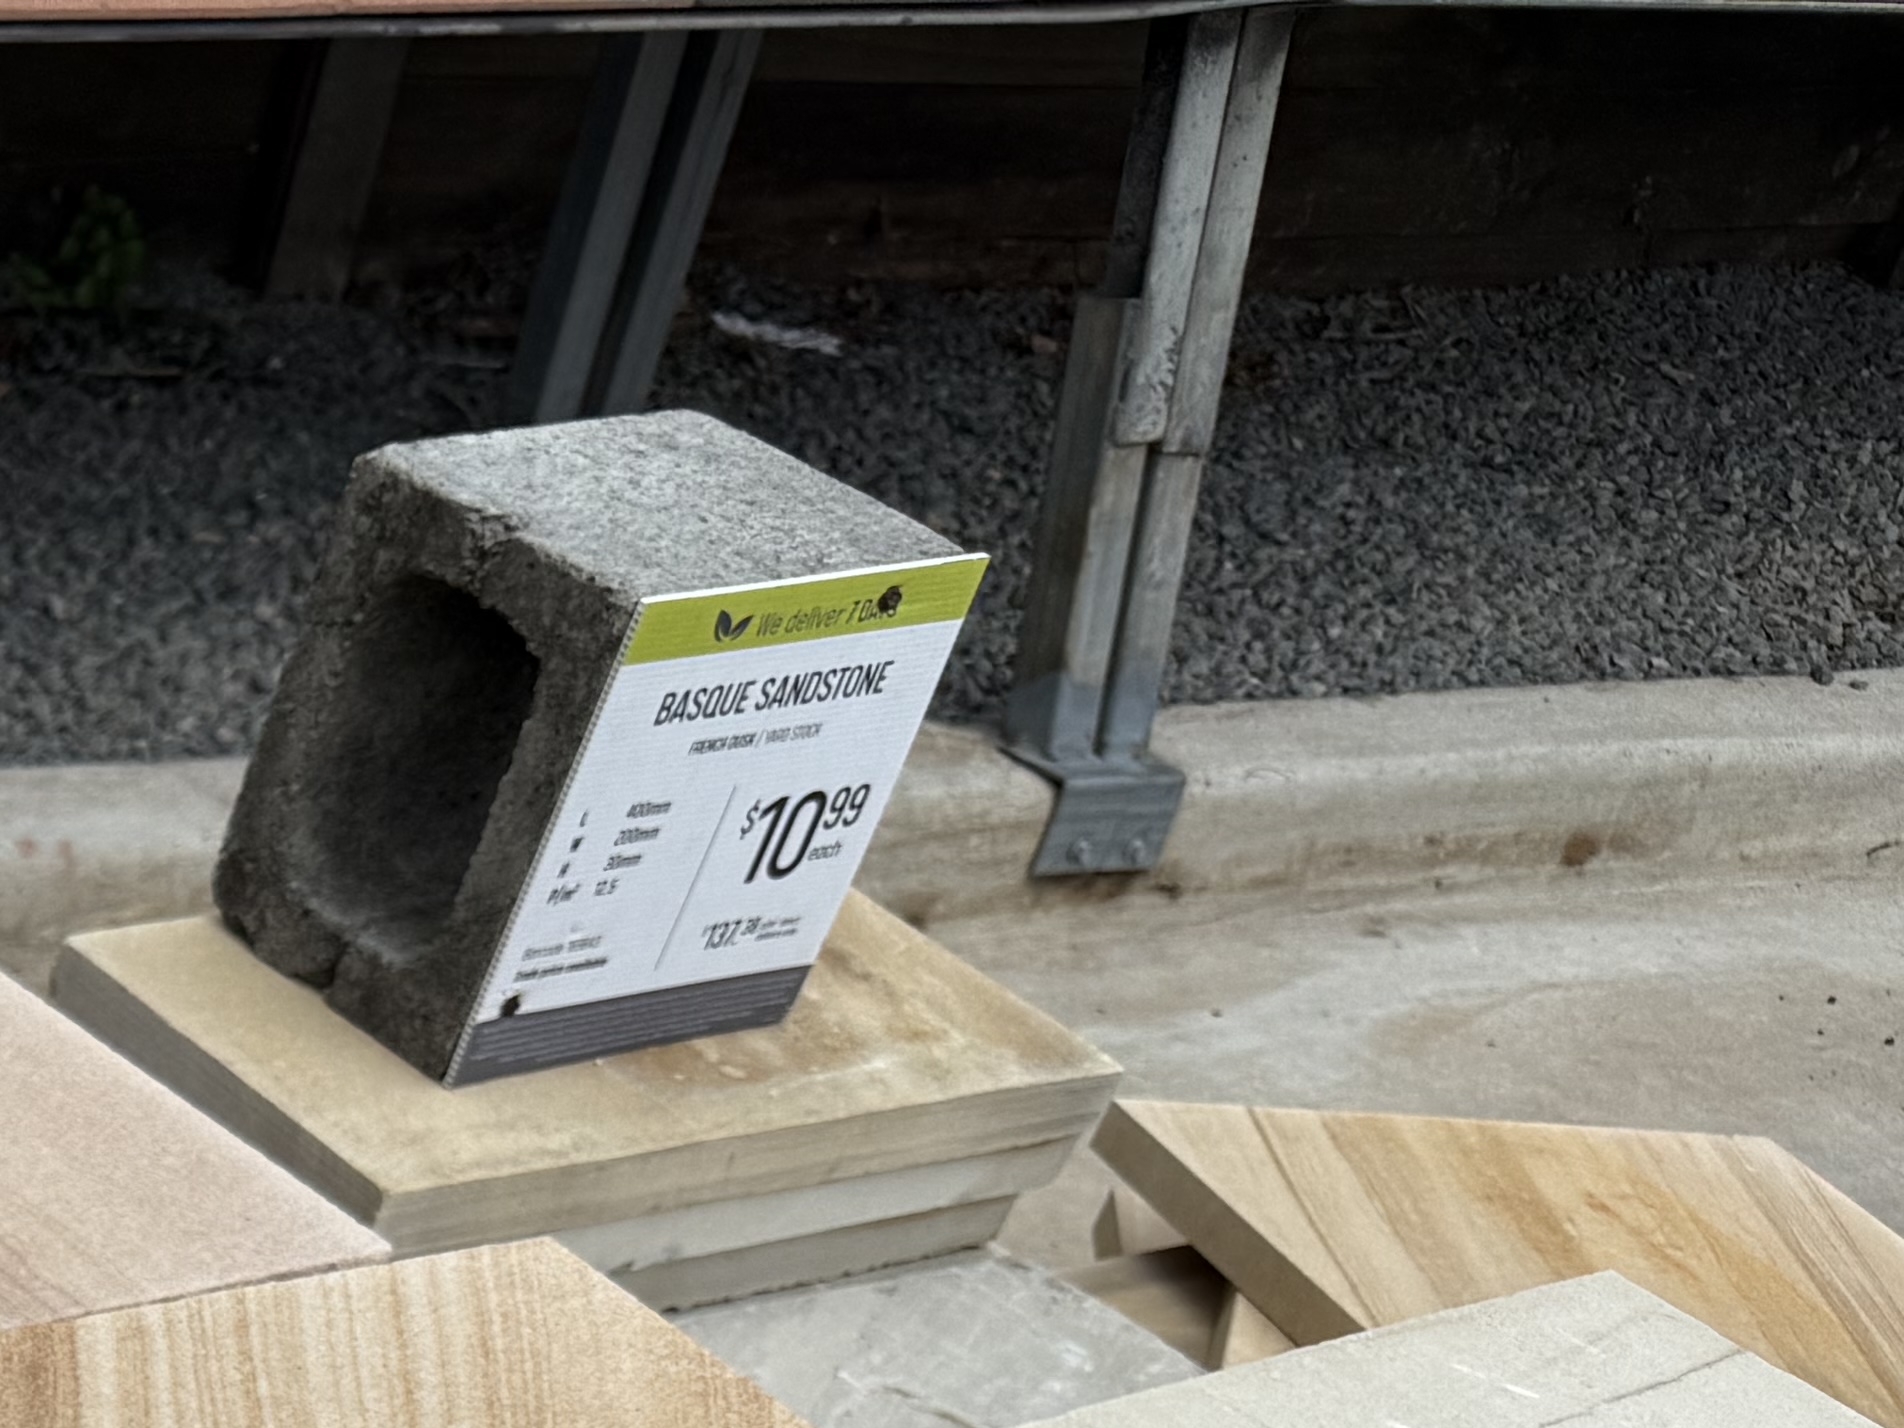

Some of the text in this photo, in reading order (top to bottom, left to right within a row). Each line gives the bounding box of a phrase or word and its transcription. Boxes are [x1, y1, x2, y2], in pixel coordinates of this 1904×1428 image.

[756, 612, 783, 637] We
[784, 606, 847, 633] deliver
[846, 600, 861, 624] 7
[654, 660, 894, 726] BASQUE SANDSTONE
[808, 841, 842, 861] each
